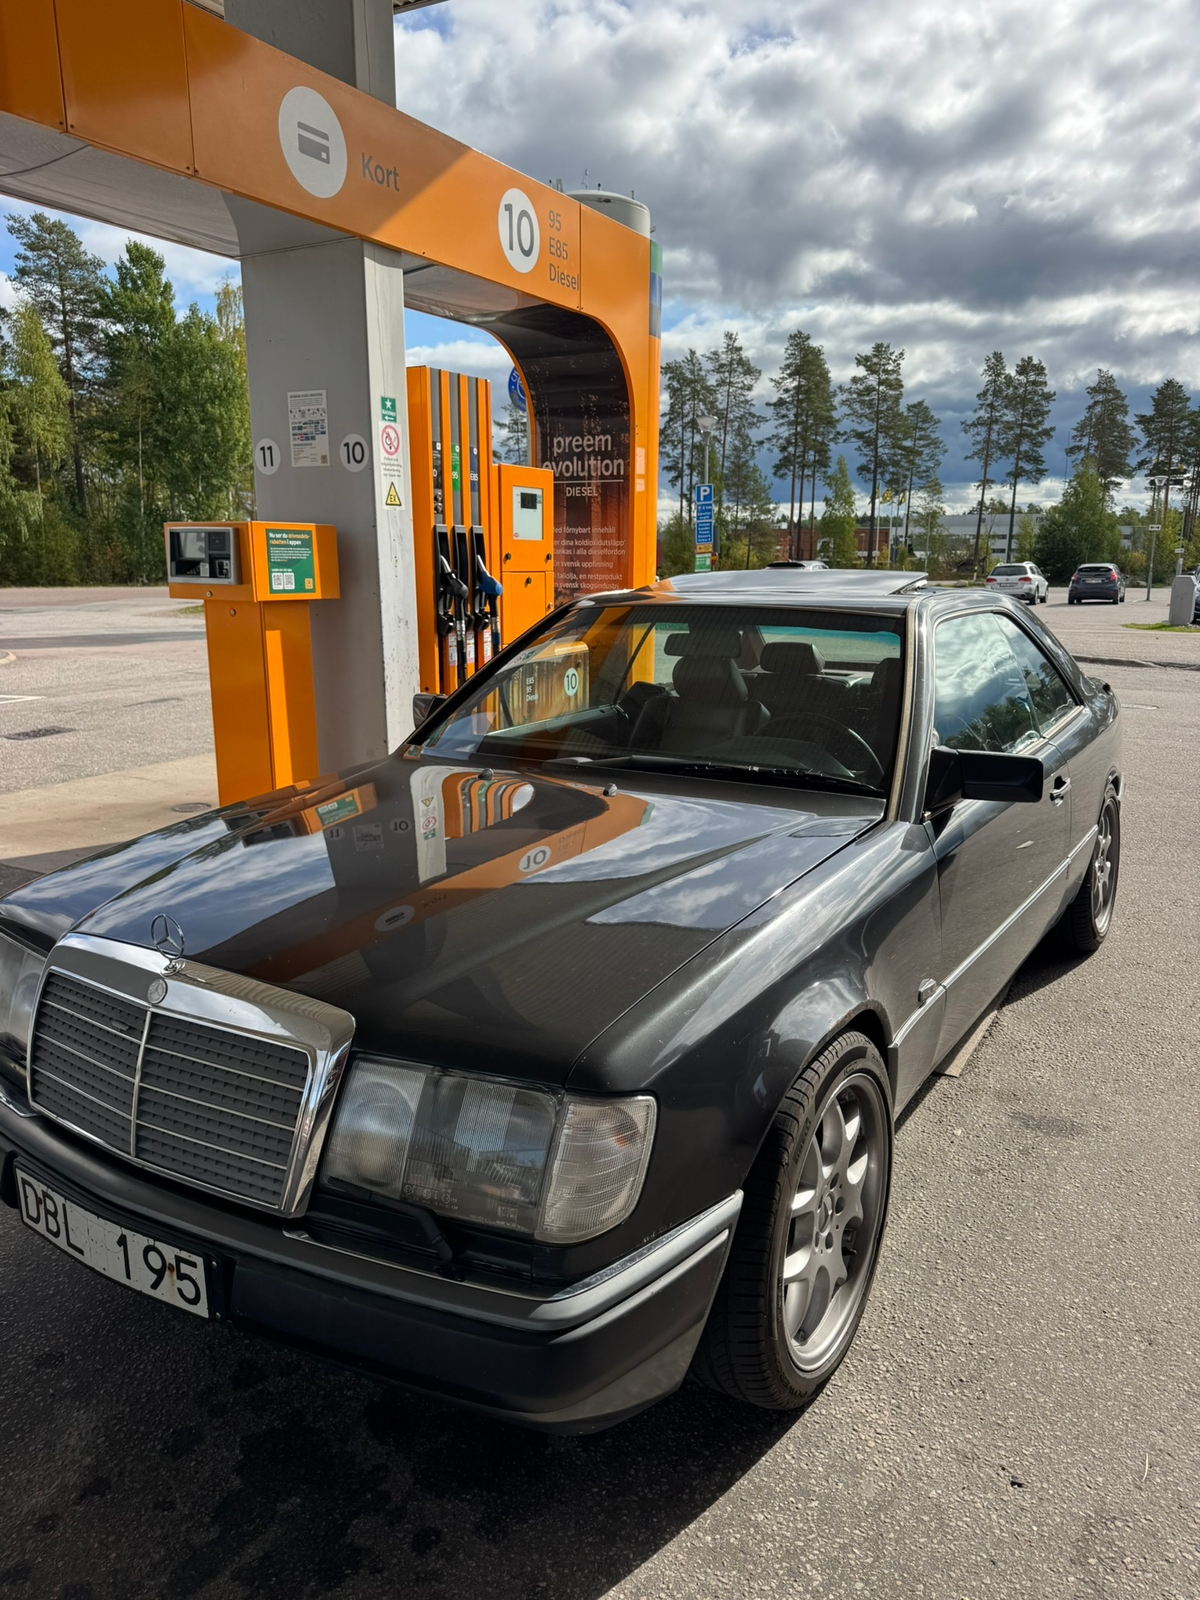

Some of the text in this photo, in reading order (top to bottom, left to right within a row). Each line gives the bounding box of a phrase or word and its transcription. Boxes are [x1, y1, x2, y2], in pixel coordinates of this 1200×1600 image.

[361, 151, 400, 192] Kort
[504, 203, 535, 258] 10
[548, 210, 562, 232] 95
[548, 236, 568, 261] E85
[548, 263, 580, 292] Diesel
[260, 445, 274, 467] 11
[343, 441, 365, 465] 10
[553, 434, 612, 457] preem
[566, 486, 599, 497] DIESEL
[700, 486, 711, 502] P
[554, 526, 616, 535] ed förnybart innehåll
[561, 559, 580, 567] svensk
[582, 560, 614, 569] uppfinning
[588, 572, 623, 580] restprodukt
[565, 672, 578, 691] 10
[20, 1176, 202, 1307] DBL 195
